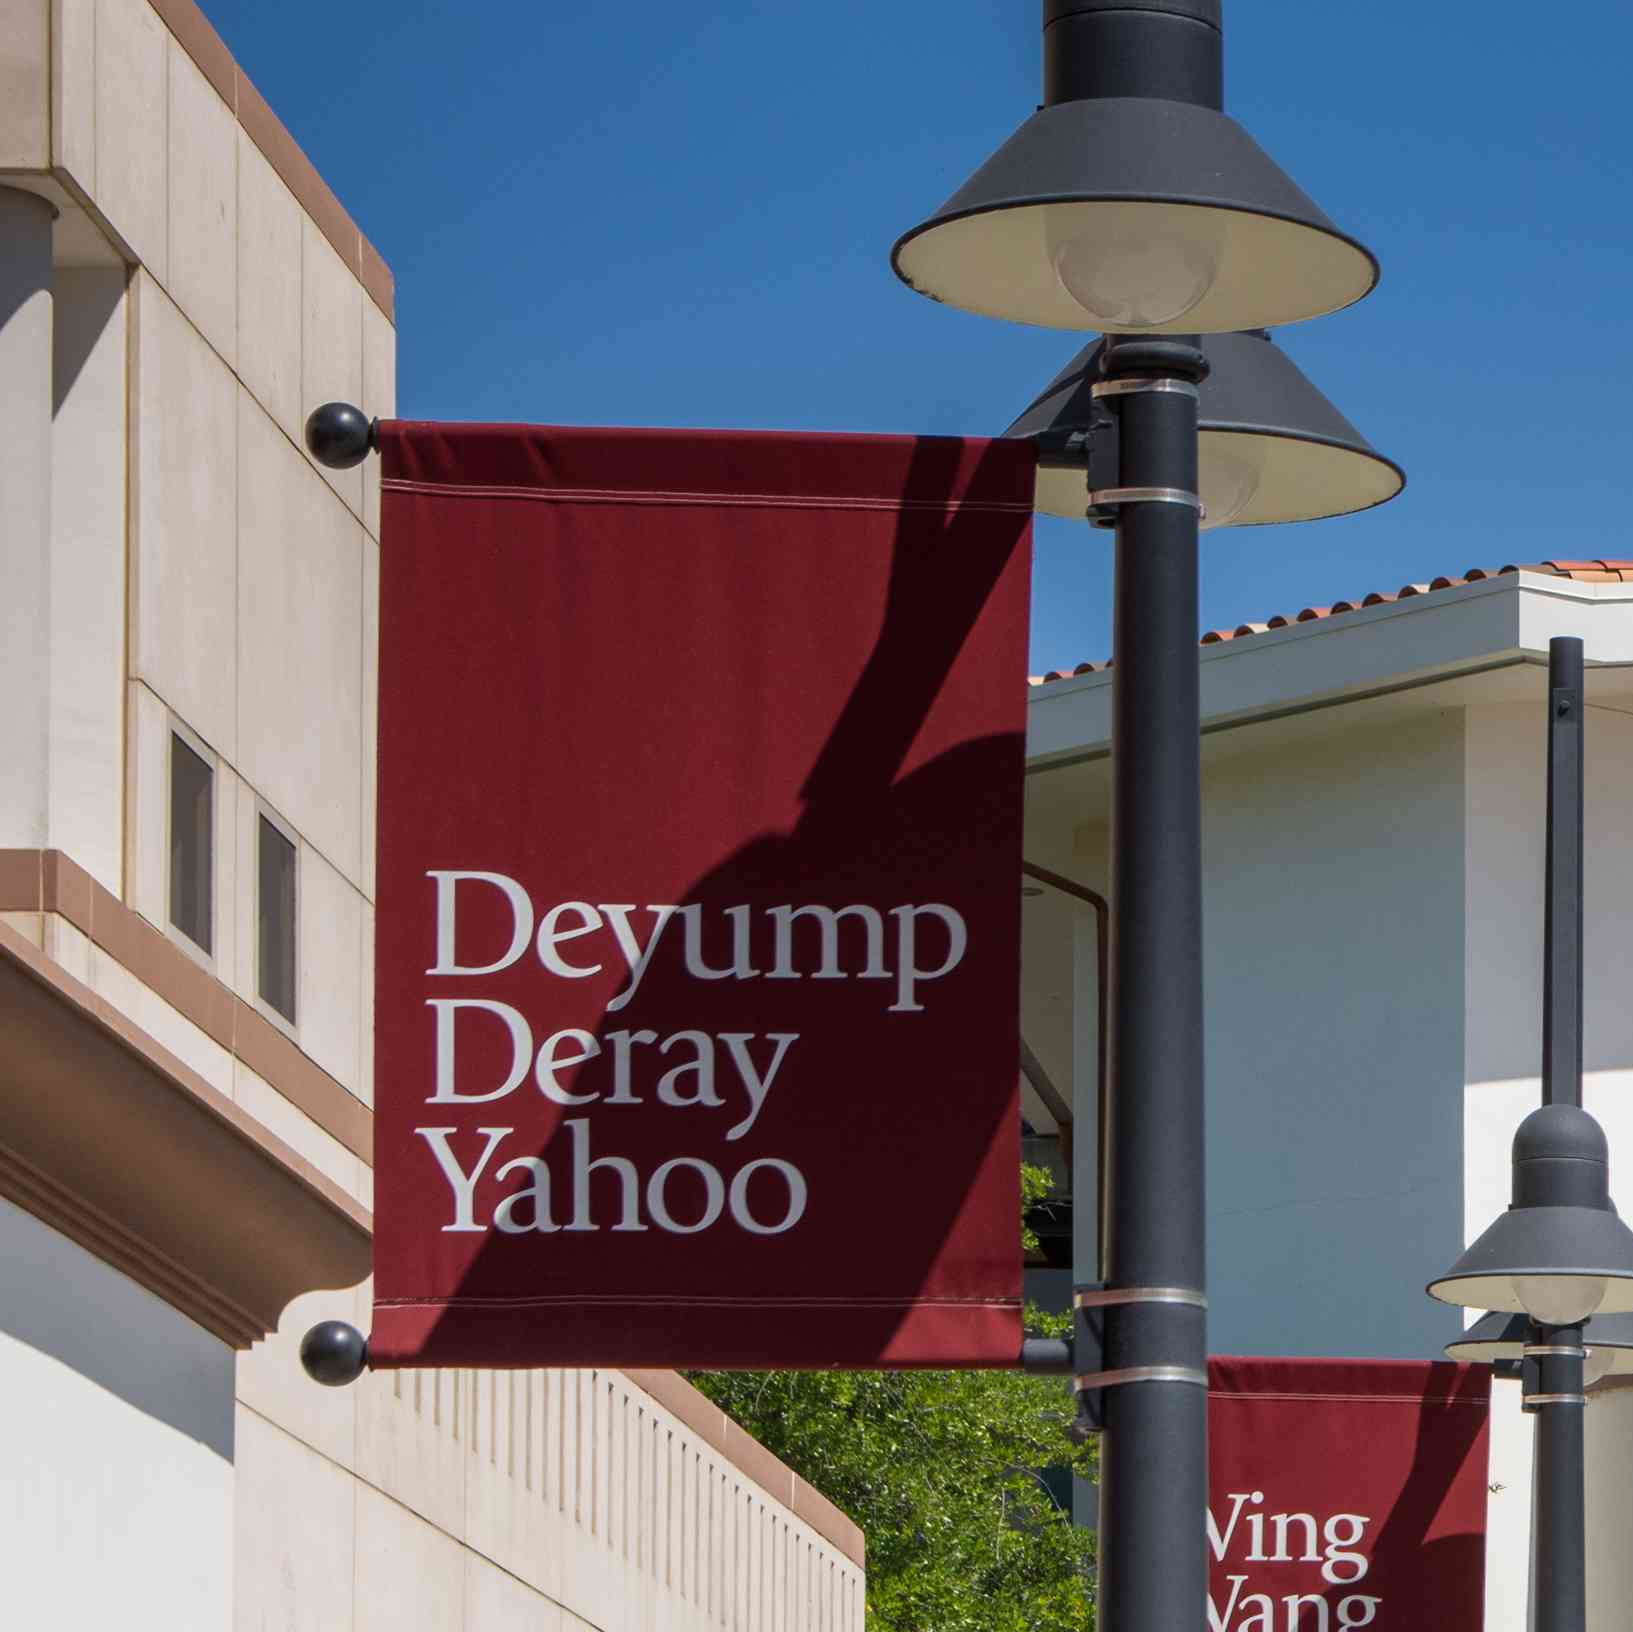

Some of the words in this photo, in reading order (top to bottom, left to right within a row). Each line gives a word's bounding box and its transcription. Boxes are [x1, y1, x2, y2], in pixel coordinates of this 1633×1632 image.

[424, 869, 968, 1013] Deyump
[424, 998, 800, 1142] Deray
[415, 1118, 808, 1235] Yahoo
